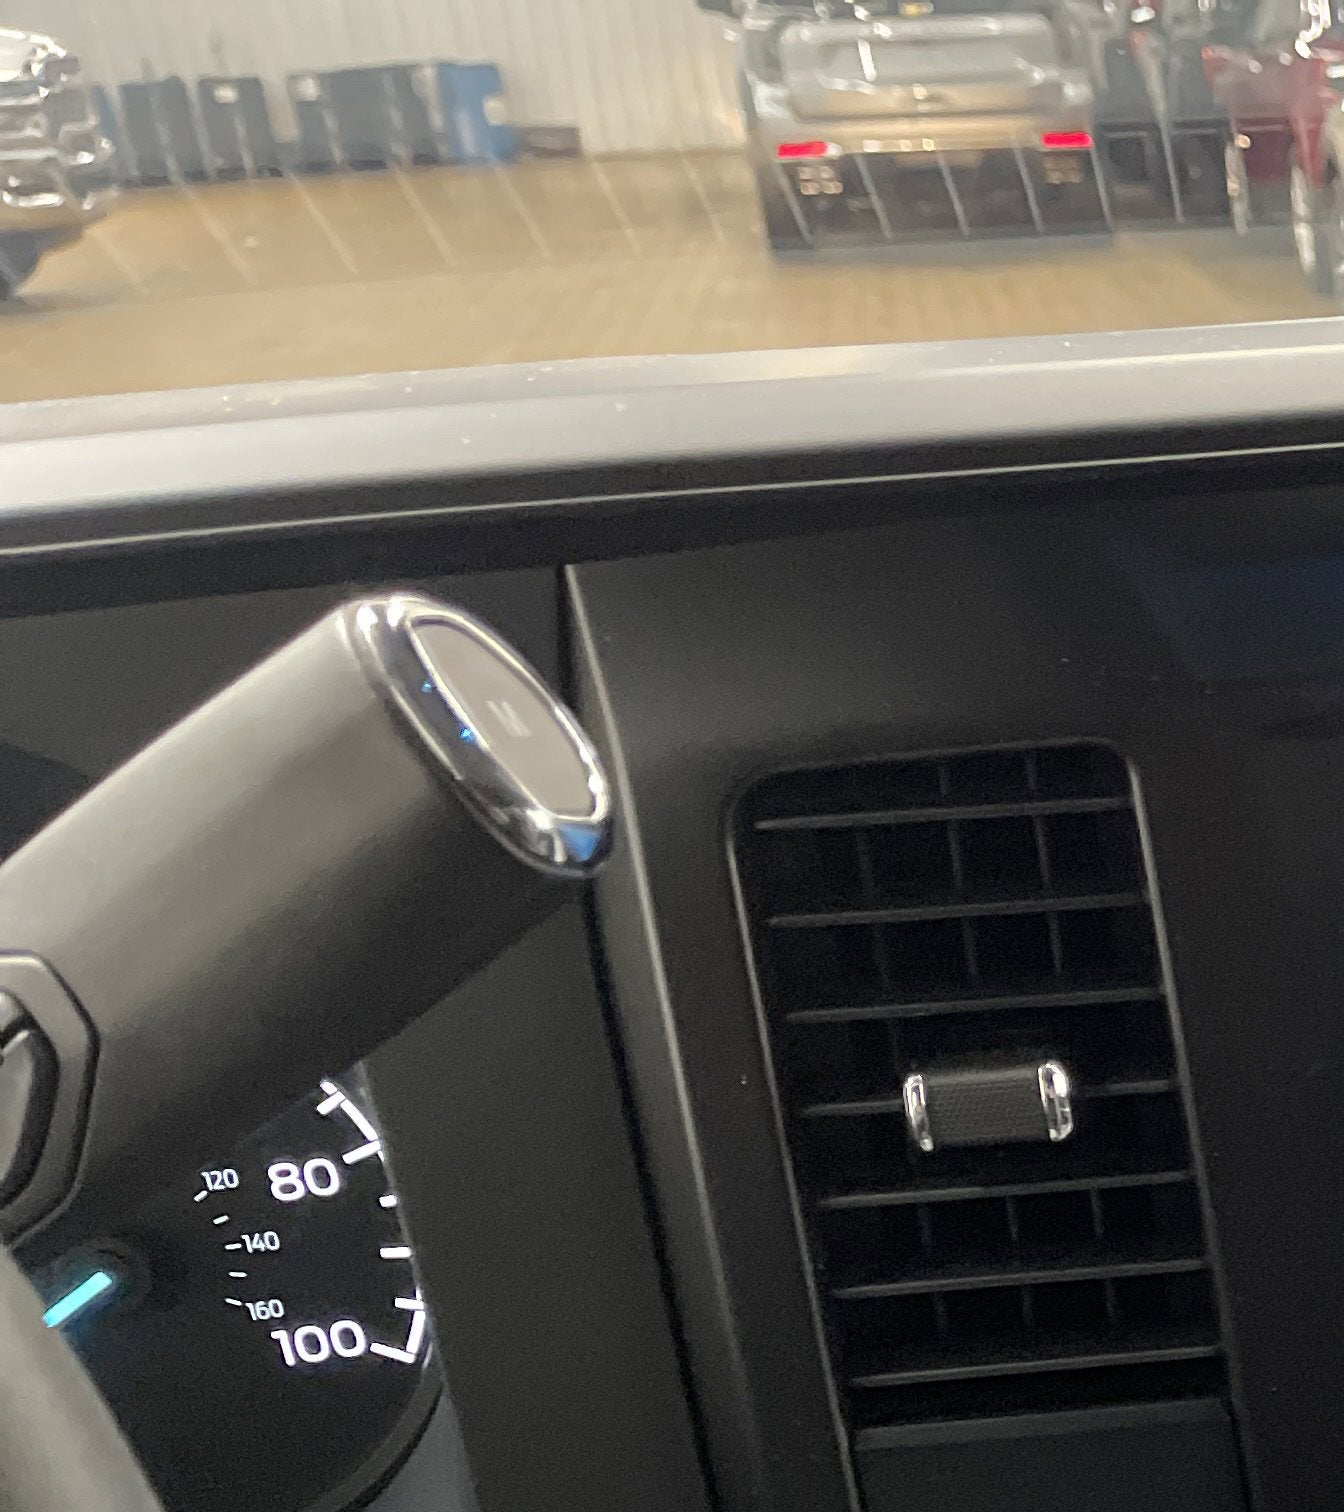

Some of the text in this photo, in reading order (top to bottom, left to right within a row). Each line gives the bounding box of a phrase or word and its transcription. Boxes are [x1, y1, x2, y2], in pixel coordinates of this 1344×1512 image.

[201, 1168, 240, 1191] 120
[266, 1157, 342, 1202] 80
[241, 1231, 281, 1253] 140
[246, 1299, 285, 1321] 160
[270, 1319, 367, 1367] 100
